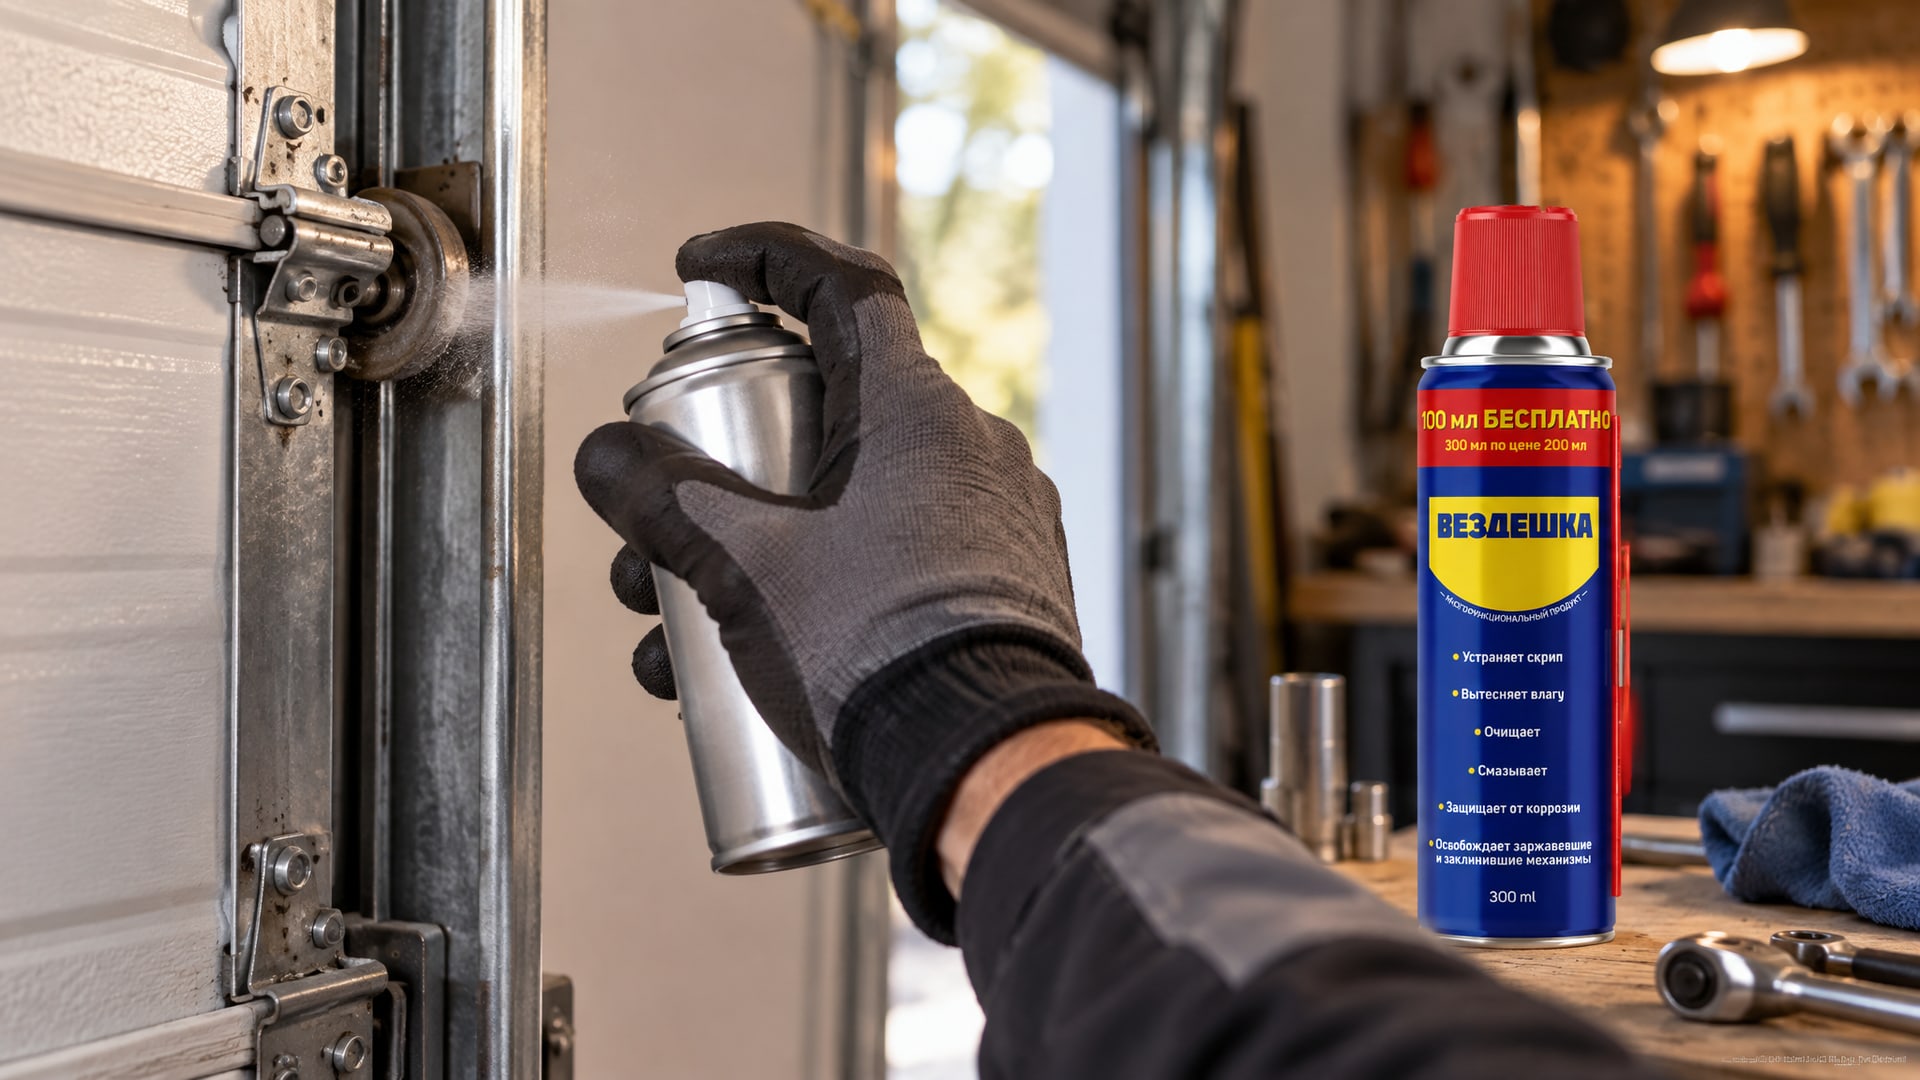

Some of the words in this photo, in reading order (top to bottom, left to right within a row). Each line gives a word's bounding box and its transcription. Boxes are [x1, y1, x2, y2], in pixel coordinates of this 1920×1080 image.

[1421, 410, 1446, 430] 100
[1450, 413, 1478, 429] мл
[1484, 408, 1611, 430] БЕСПЛАТНО
[1445, 439, 1468, 451] 300
[1470, 441, 1487, 451] мл
[1490, 441, 1506, 451] по
[1509, 441, 1541, 453] цене
[1544, 439, 1569, 451] 200
[1571, 441, 1587, 451] мл
[1437, 513, 1593, 538] ВЕЗДЕШКА
[1549, 594, 1582, 616] ПРОДУКТ
[1462, 651, 1524, 664] Устраняет
[1527, 653, 1563, 665] скрип
[1461, 689, 1528, 700] Вытесняет
[1531, 690, 1565, 702] влагу
[1484, 726, 1541, 739] Очищает
[1478, 765, 1548, 776] Смазывает
[1446, 801, 1507, 815] Защищает
[1509, 803, 1523, 814] от
[1526, 803, 1581, 815] коррозии
[1435, 838, 1511, 853] Освобождает
[1513, 840, 1592, 854] заржавевшие
[1436, 854, 1442, 863] и
[1444, 854, 1523, 865] заклинившие
[1526, 855, 1592, 865] механизмы
[1489, 890, 1517, 903] 300
[1519, 890, 1536, 903] ml
